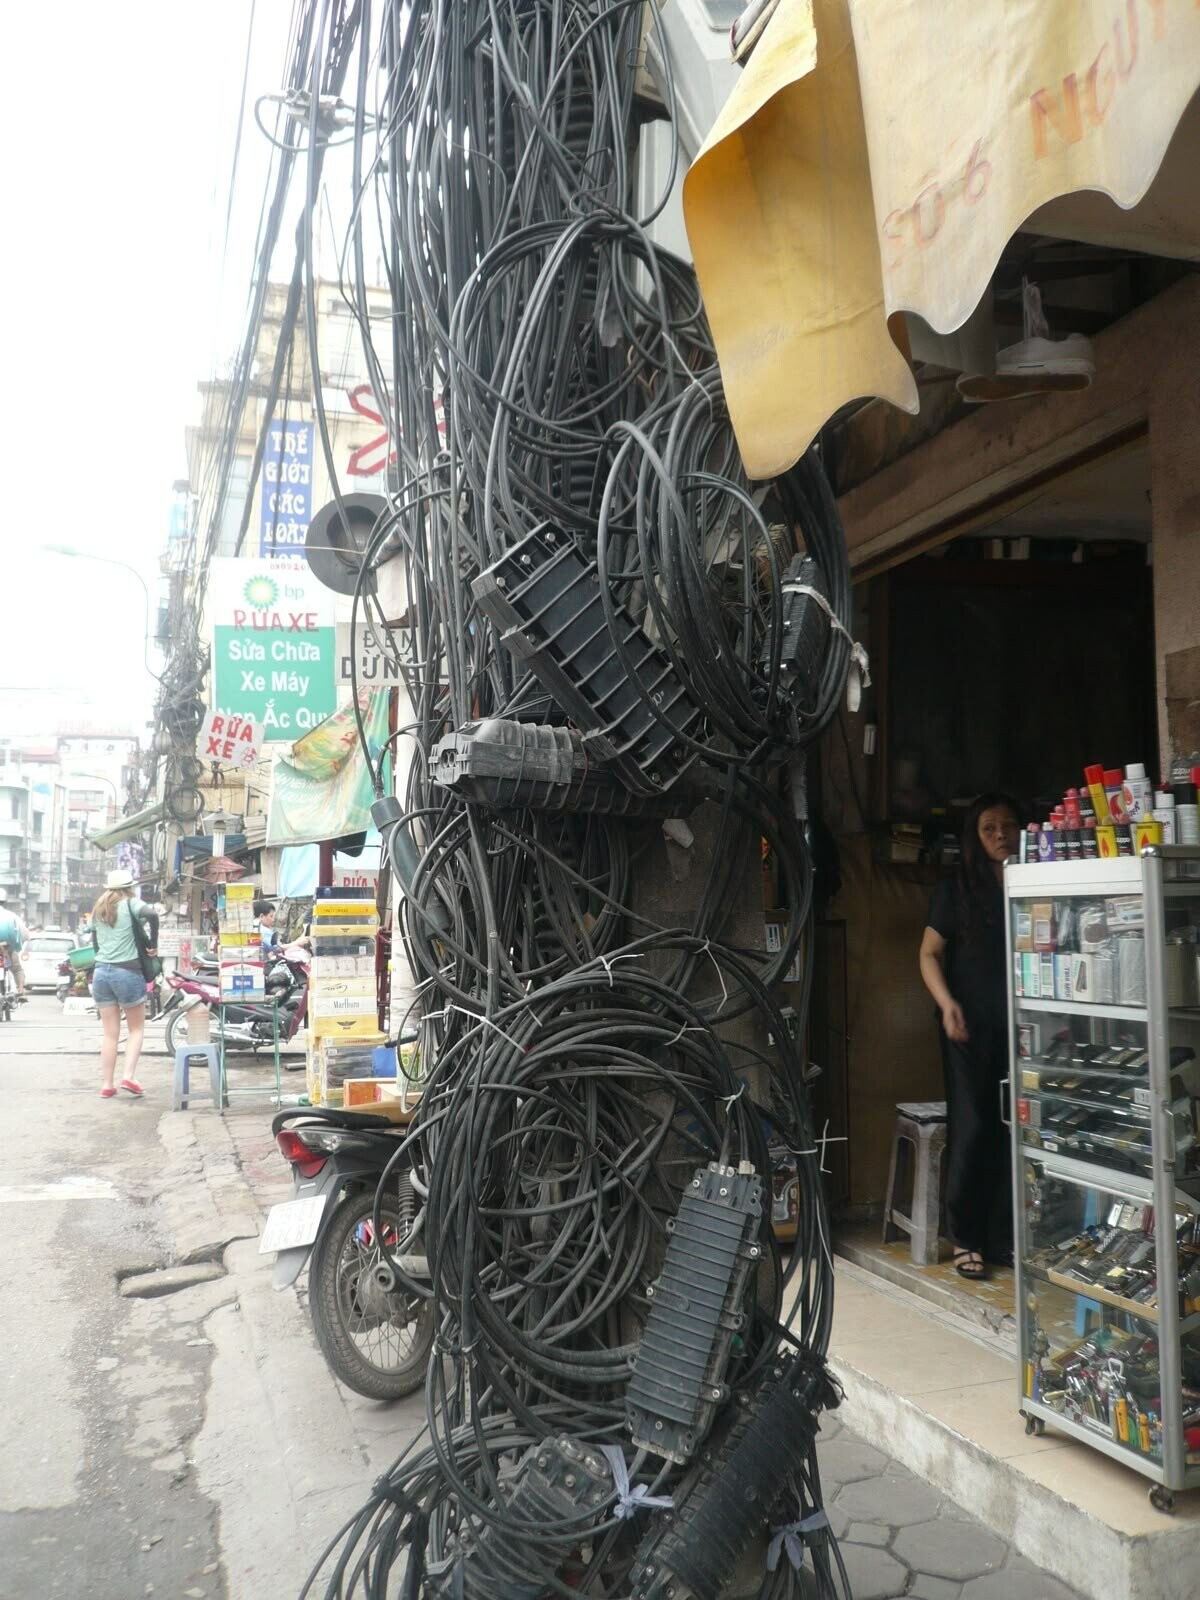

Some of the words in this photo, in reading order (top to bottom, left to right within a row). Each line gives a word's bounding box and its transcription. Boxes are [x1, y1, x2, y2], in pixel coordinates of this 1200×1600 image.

[284, 584, 305, 600] bp
[228, 638, 265, 661] Sửa
[271, 640, 321, 661] Chữa
[241, 670, 266, 691] Xe
[271, 670, 310, 697] Máy
[262, 698, 291, 728] Ắc
[206, 736, 236, 760] XE
